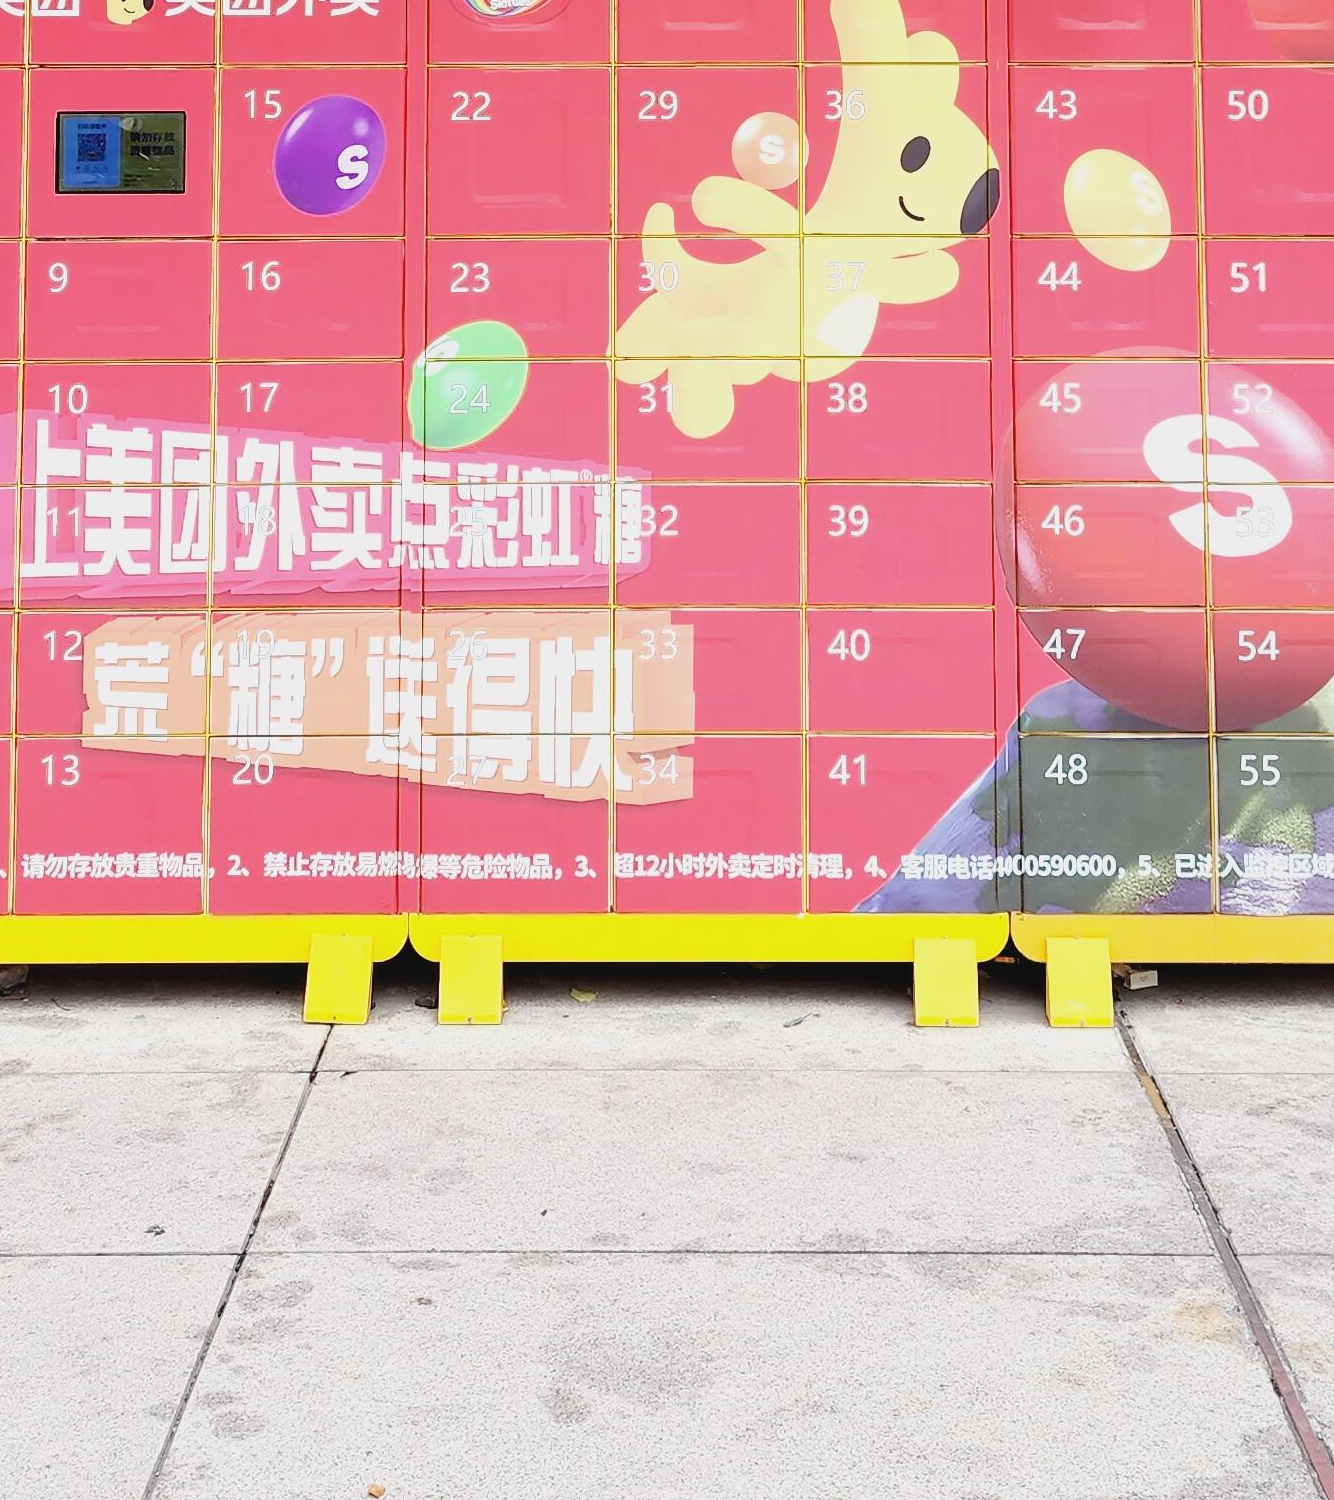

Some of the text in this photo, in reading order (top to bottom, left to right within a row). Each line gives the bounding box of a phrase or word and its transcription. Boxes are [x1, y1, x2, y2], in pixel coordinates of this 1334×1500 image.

[244, 90, 282, 120] 15
[450, 91, 491, 121] 22
[637, 90, 678, 120] 29
[825, 90, 865, 120] 36
[1035, 91, 1078, 121] 43
[1227, 90, 1269, 121] 50
[758, 134, 785, 164] S
[336, 144, 370, 190] S
[48, 263, 68, 293] 9
[241, 261, 281, 291] 16
[450, 262, 490, 292] 23
[638, 262, 679, 292] 30
[826, 261, 865, 291] 37
[1038, 262, 1081, 291] 44
[1230, 262, 1267, 293] 51
[48, 384, 88, 414] 10
[239, 382, 279, 412] 17
[449, 384, 491, 413] 24
[638, 383, 675, 413] 31
[827, 383, 867, 413] 38
[1039, 383, 1081, 413] 45
[1233, 384, 1273, 414] 52
[1142, 413, 1293, 558] S
[46, 508, 81, 537] 11
[639, 506, 678, 536] 32
[828, 505, 868, 536] 39
[1041, 505, 1085, 535] 46
[43, 631, 83, 660] 12
[638, 630, 677, 659] 33
[827, 629, 871, 660] 40
[1042, 629, 1086, 660] 47
[1238, 631, 1279, 661] 54
[41, 756, 80, 786] 13
[232, 755, 274, 785] 20
[639, 755, 679, 786] 34
[828, 755, 866, 786] 41
[1045, 754, 1088, 785] 48
[1240, 755, 1281, 786] 55
